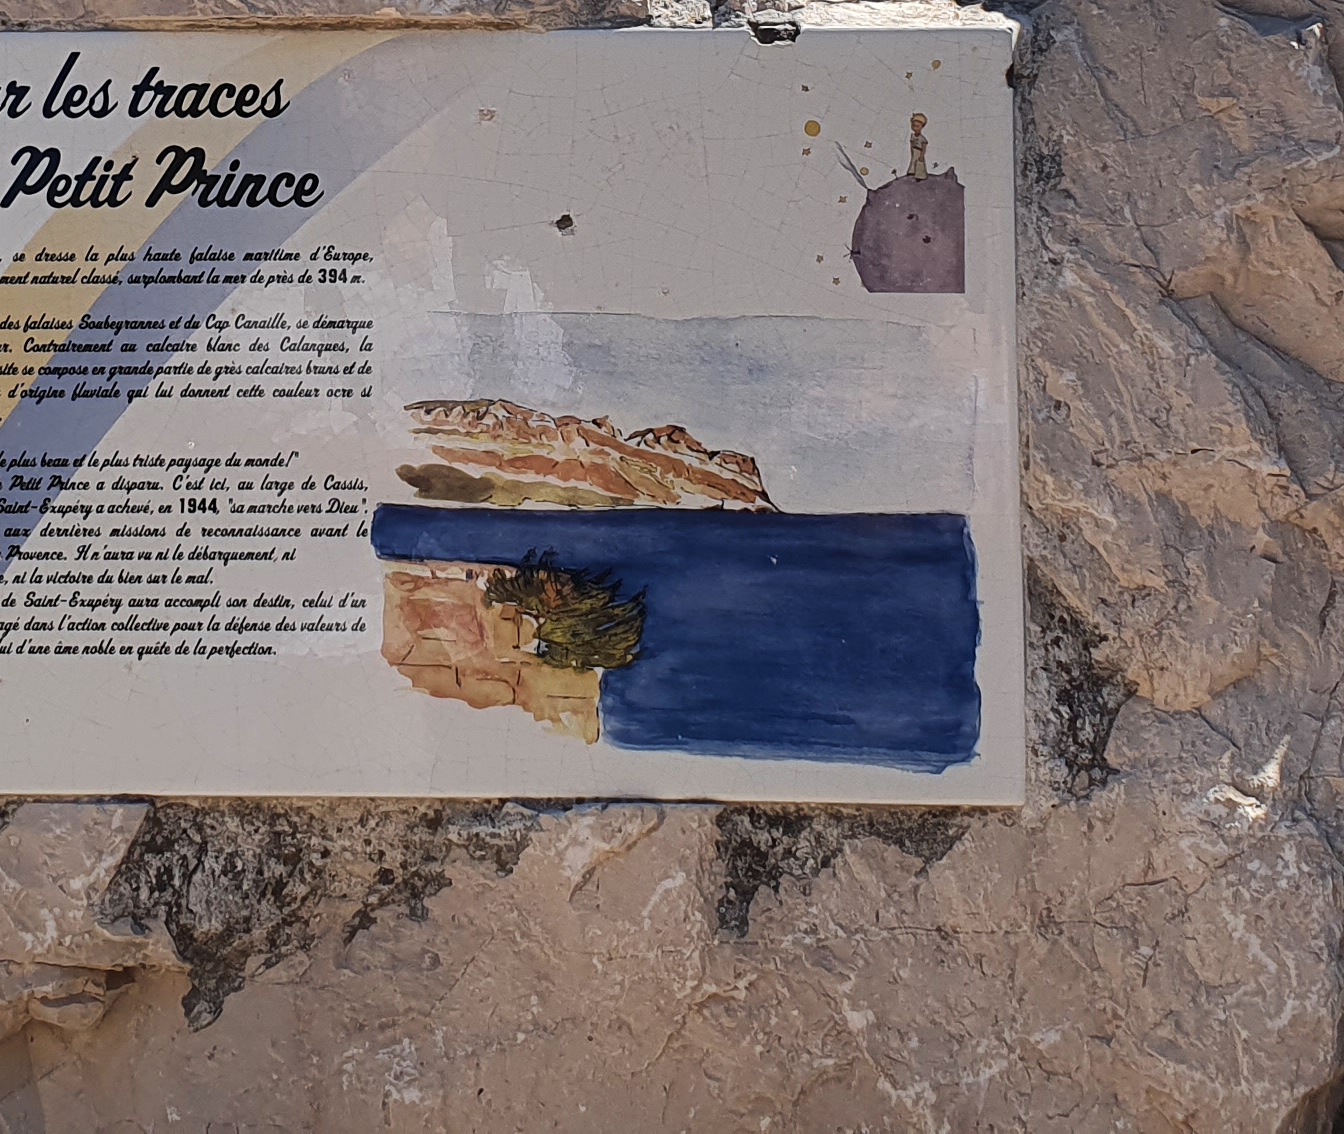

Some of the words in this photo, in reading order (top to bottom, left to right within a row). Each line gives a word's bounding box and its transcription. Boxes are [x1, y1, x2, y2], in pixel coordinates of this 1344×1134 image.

[42, 52, 118, 119] les
[128, 67, 290, 118] traces
[0, 146, 135, 208] Petit
[145, 145, 324, 208] Prince
[35, 247, 77, 262] dresse
[85, 245, 99, 262] la
[104, 245, 136, 266] plus
[143, 246, 182, 261] haute
[189, 245, 235, 264] falaise
[242, 249, 301, 261] maritime
[310, 245, 373, 265] d'Europe,
[30, 268, 79, 284] naturel
[81, 267, 123, 285] classé,
[127, 267, 205, 289] surplombant
[206, 267, 221, 284] la
[222, 274, 247, 284] mer
[250, 269, 265, 283] de
[264, 270, 294, 288] près
[298, 269, 313, 284] de
[318, 268, 347, 283] 394
[0, 315, 21, 330] des
[23, 313, 73, 333] falaises
[78, 314, 166, 335] Soubeyrannes
[184, 314, 201, 329] du
[206, 314, 231, 333] Cap
[235, 312, 291, 330] Canaille,
[312, 314, 374, 334] démarque
[24, 337, 114, 353] Contrairement
[146, 335, 197, 352] calcaire
[206, 335, 240, 352] blanc
[249, 337, 270, 352] des
[280, 335, 349, 357] Calanques,
[359, 335, 373, 352] la
[38, 365, 89, 380] compose
[106, 360, 154, 381] grande
[153, 362, 194, 379] partie
[197, 360, 212, 375] de
[212, 361, 242, 381] grès
[245, 358, 302, 375] calcaires
[306, 360, 340, 375] bruns
[357, 360, 372, 374] de
[8, 383, 66, 405] d'origine
[71, 381, 121, 401] fluviale
[127, 386, 149, 404] qui
[155, 381, 174, 398] lui
[180, 383, 231, 398] donnent
[236, 385, 265, 398] cette
[272, 381, 320, 398] couleur
[326, 388, 354, 398] ocre
[6, 450, 37, 472] plus
[40, 452, 70, 467] beau
[99, 450, 130, 472] plus
[133, 454, 166, 467] triste
[165, 457, 222, 474] paysage
[225, 452, 242, 467] du
[9, 475, 43, 491] Petit
[47, 475, 90, 491] Prince
[111, 475, 163, 495] disparu.
[173, 474, 205, 491] C'est
[209, 478, 230, 492] ici,
[260, 473, 295, 497] large
[301, 475, 317, 490] de
[324, 474, 368, 492] Cassis,
[107, 498, 154, 515] achevé,
[179, 498, 220, 515] 1944,
[246, 498, 294, 514] marche
[296, 504, 323, 514] vers
[4, 528, 31, 537] aux
[40, 522, 102, 537] dernières
[109, 525, 166, 537] missions
[176, 522, 191, 537] de
[201, 525, 302, 537] reconnaissance
[310, 523, 349, 537] avant
[5, 545, 67, 561] Provence.
[74, 543, 92, 561] Il
[90, 545, 135, 561] n'aura
[172, 543, 184, 561] le
[188, 545, 278, 566] débarquement,
[29, 567, 43, 584] la
[46, 570, 94, 584] victoire
[97, 569, 115, 584] du
[118, 569, 143, 584] bien
[146, 574, 167, 584] sur
[185, 567, 213, 584] mal.
[1, 592, 17, 607] de
[24, 591, 123, 614] Saint-Exupéry
[128, 598, 160, 608] aura
[164, 590, 221, 612] accompli
[226, 598, 247, 608] son
[253, 592, 295, 609] destin,
[302, 591, 333, 608] celui
[338, 592, 367, 608] d'un
[24, 616, 54, 631] dans
[58, 614, 107, 631] l'action
[111, 614, 170, 631] collective
[170, 621, 203, 636] pour
[207, 614, 221, 631] la
[224, 616, 271, 635] défense
[275, 616, 297, 631] des
[300, 614, 347, 632] valeurs
[351, 617, 366, 632] de
[16, 638, 51, 655] d'une
[54, 641, 79, 655] âme
[81, 638, 116, 655] noble
[137, 641, 171, 661] quête
[175, 640, 190, 655] de
[193, 638, 207, 655] la
[206, 640, 276, 660] perfection.
